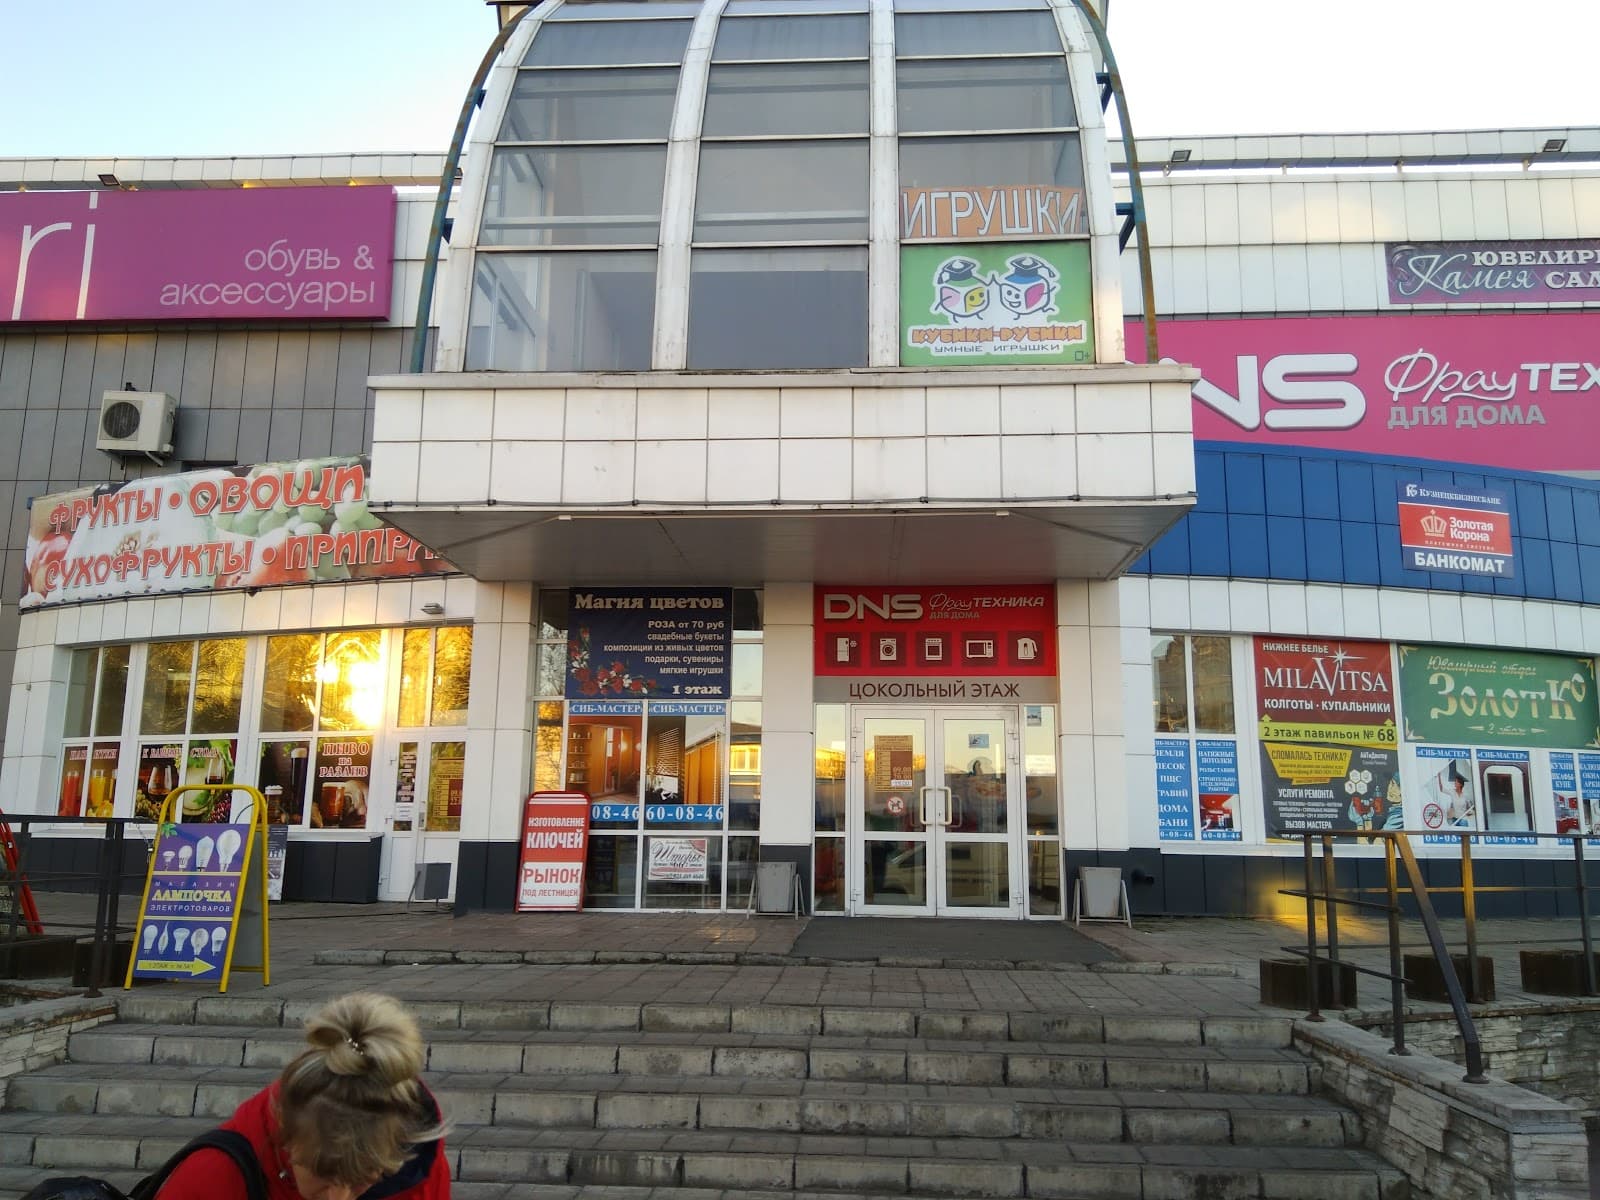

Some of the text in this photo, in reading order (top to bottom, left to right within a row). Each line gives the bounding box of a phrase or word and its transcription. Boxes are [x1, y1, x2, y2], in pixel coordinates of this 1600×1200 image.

[903, 189, 1080, 239] ИГРУШКИ
[244, 239, 375, 277] обувь &
[1398, 253, 1536, 296] Камея
[159, 280, 376, 311] аксессуары
[911, 324, 1083, 344] КУБИКИ-РУБИКИ
[934, 343, 1061, 353] УМНЫЕ ИГРУШКИ
[1387, 404, 1546, 430] ДЛЯ ДОМА
[48, 487, 163, 535] ФРУКТЫ
[1449, 516, 1494, 532] Золотая
[1450, 528, 1490, 543] Корона
[43, 540, 255, 592] СУХОФРУКТЫ
[1414, 551, 1505, 574] БАНКОМАТ
[574, 593, 725, 610] Магия цветов
[823, 593, 924, 620] DNS
[929, 611, 980, 620] ДЛЯ ДОМА
[648, 620, 725, 630] РОЗА от 70 руб
[647, 631, 724, 641] свадебные букеты
[603, 644, 724, 653] композиции из живых цветов
[1262, 642, 1329, 654] НИЖНЕЕ БЕЛЬЕ
[645, 655, 724, 665] подарки, сувениры
[659, 667, 724, 676] мягкие игрушки
[672, 685, 723, 695] 1 этаж
[849, 680, 1021, 699] ЦОКОЛЬНЫЙ ЭТАЖ
[1264, 698, 1391, 713] КОЛГОТЫ КУПАЛЬНИКИ
[1263, 726, 1271, 737] 2
[1273, 728, 1301, 738] этаж
[1304, 729, 1360, 740] павильон
[1377, 728, 1395, 742] 68
[322, 741, 370, 756] ПИВО
[1271, 749, 1313, 760] СЛОМАЛАСЬ
[337, 757, 352, 766] на
[319, 765, 368, 778] РАЗЛИВ
[1278, 788, 1335, 800] УСЛУГИ РЕМОНТА
[646, 805, 724, 821] 60-08-46
[528, 817, 585, 827] ИЗГОТОВЛЕНИЕ
[1159, 818, 1188, 827] БАНИ
[1285, 820, 1333, 830] ВЫЗОВ МАСТЕРА
[526, 829, 584, 849] КЛЮЧЕЙ
[523, 868, 581, 884] РЫНОК
[151, 888, 232, 902] ЛАМПОЧКА
[522, 888, 537, 898] ПОД
[150, 903, 230, 912] ЭЛЕКТРОТОВАРОВ
